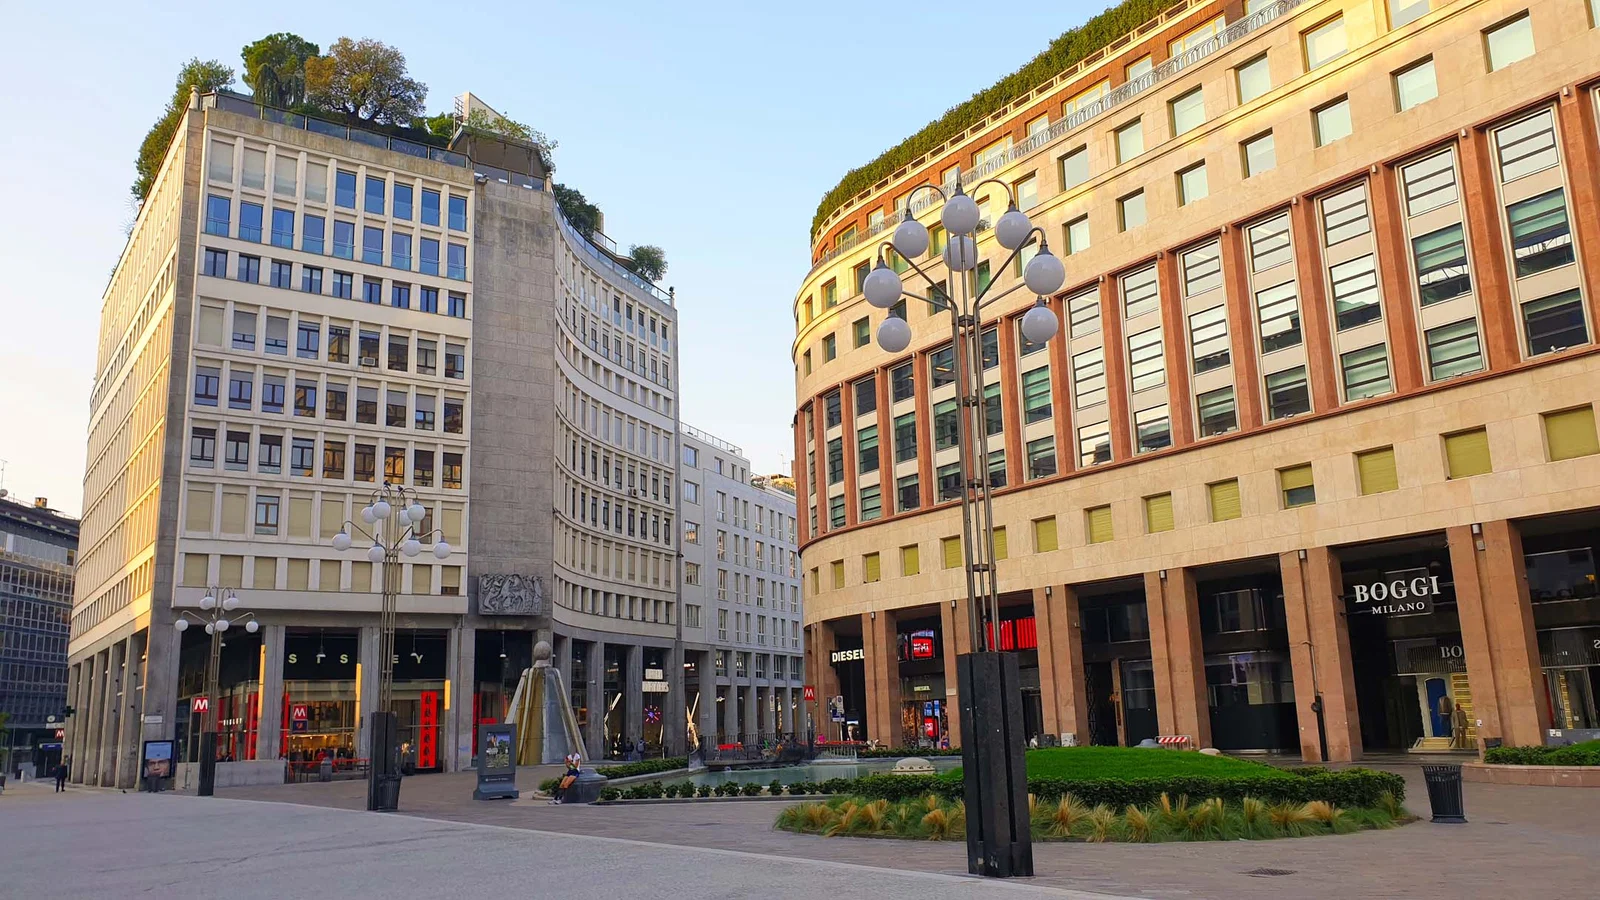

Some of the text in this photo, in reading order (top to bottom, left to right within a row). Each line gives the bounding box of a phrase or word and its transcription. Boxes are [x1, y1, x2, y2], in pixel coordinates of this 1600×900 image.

[1353, 576, 1441, 603] BOGGI
[1372, 602, 1425, 615] MILANO
[288, 653, 424, 664] SISEY
[832, 649, 864, 662] DIESEL
[804, 688, 814, 697] M
[194, 699, 208, 710] M
[294, 708, 306, 717] M
